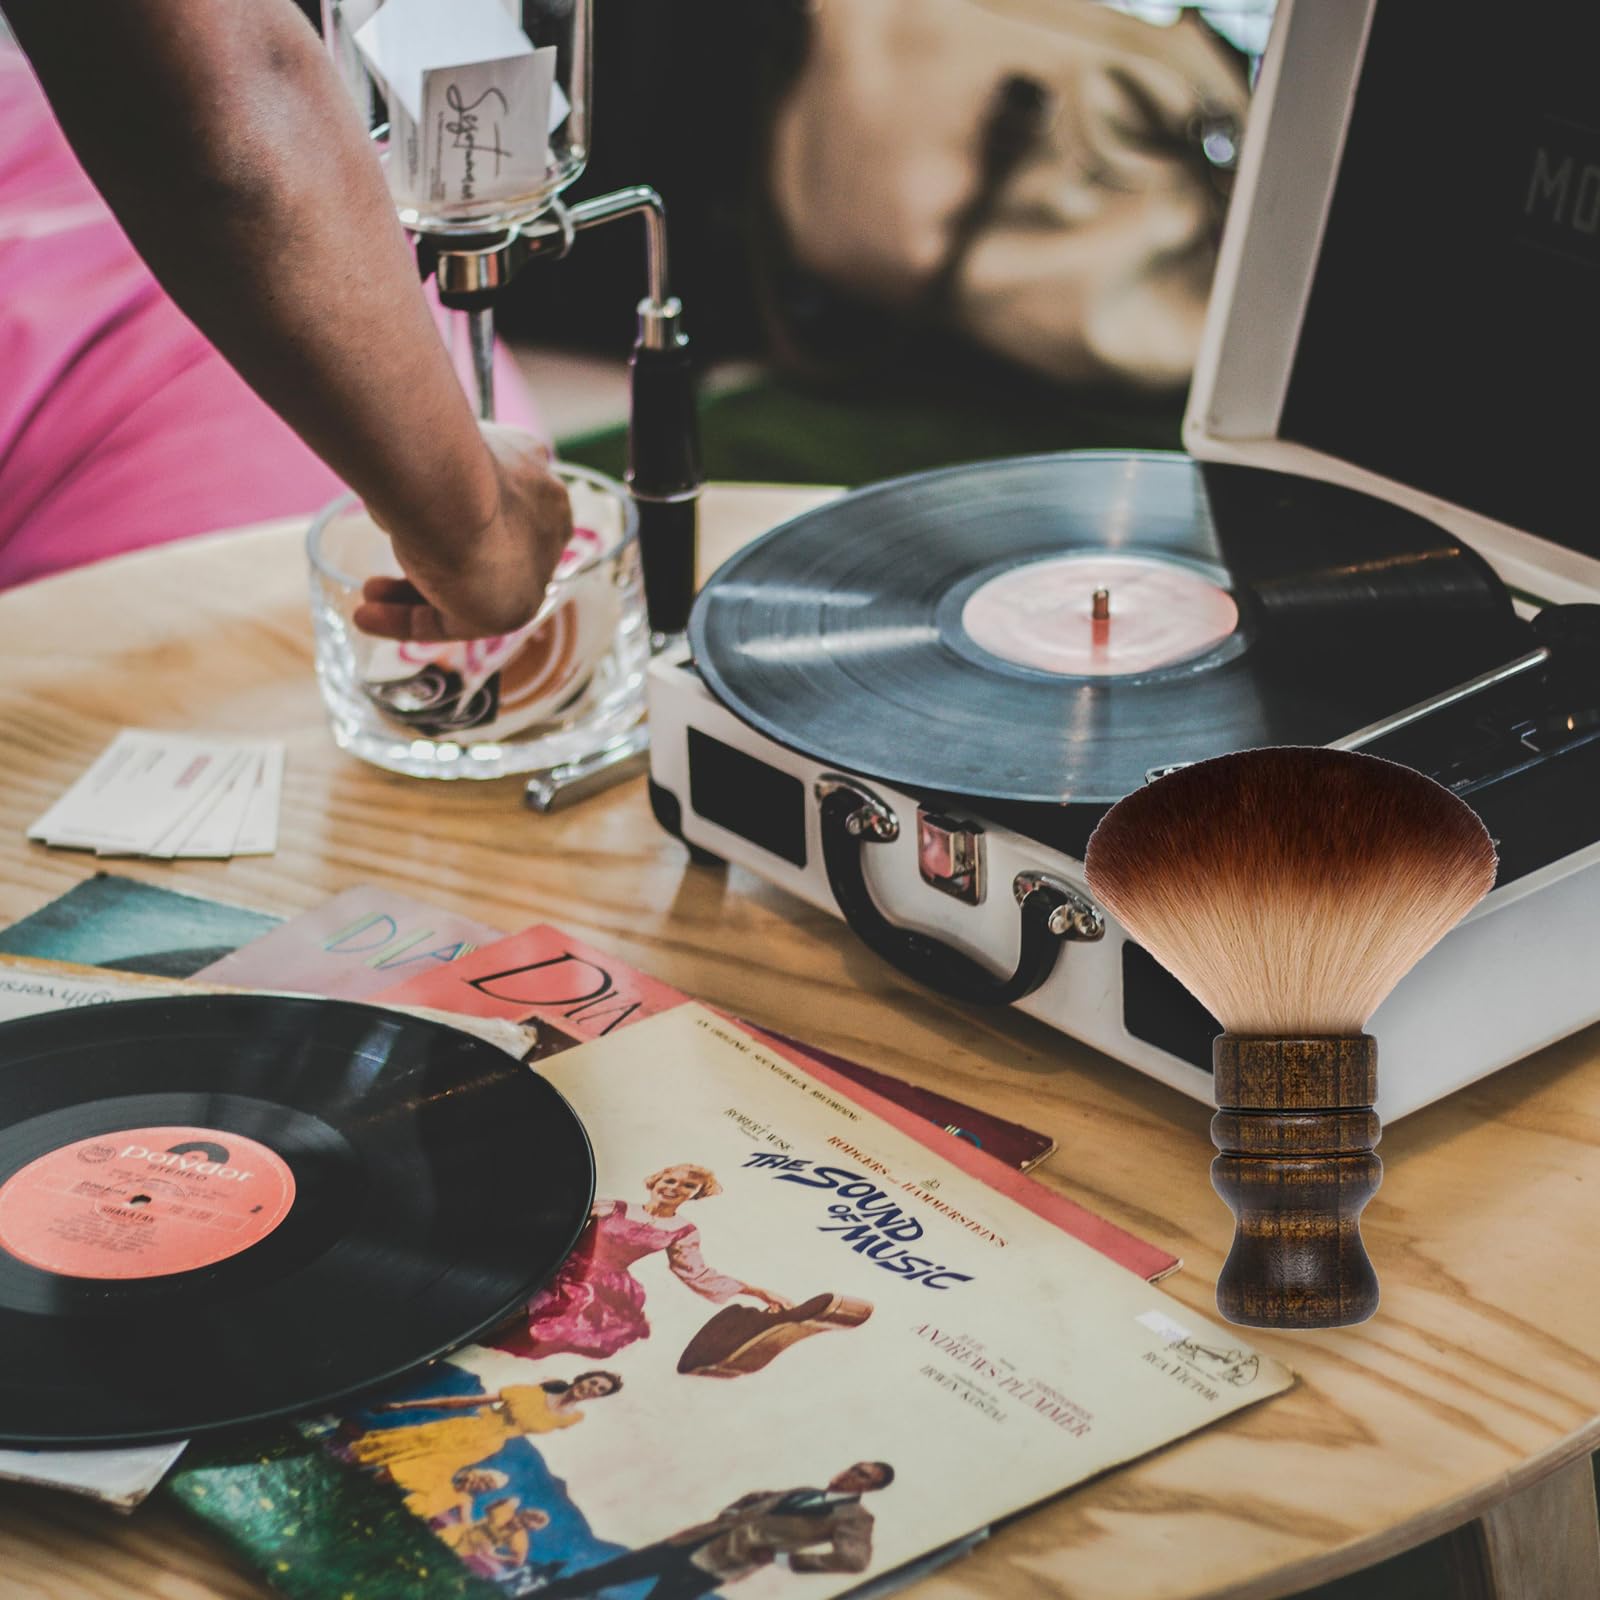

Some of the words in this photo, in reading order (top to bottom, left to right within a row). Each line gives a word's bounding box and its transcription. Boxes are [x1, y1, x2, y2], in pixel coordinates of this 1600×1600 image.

[120, 1143, 256, 1184] polydor
[147, 1164, 209, 1182] STEREO
[741, 1152, 813, 1172] THE
[826, 1135, 892, 1181] RODGERS
[772, 1166, 924, 1242] SOUND
[827, 1204, 862, 1224] OF
[909, 1323, 998, 1378] ANDREWS
[998, 1376, 1092, 1438] PLUMMER
